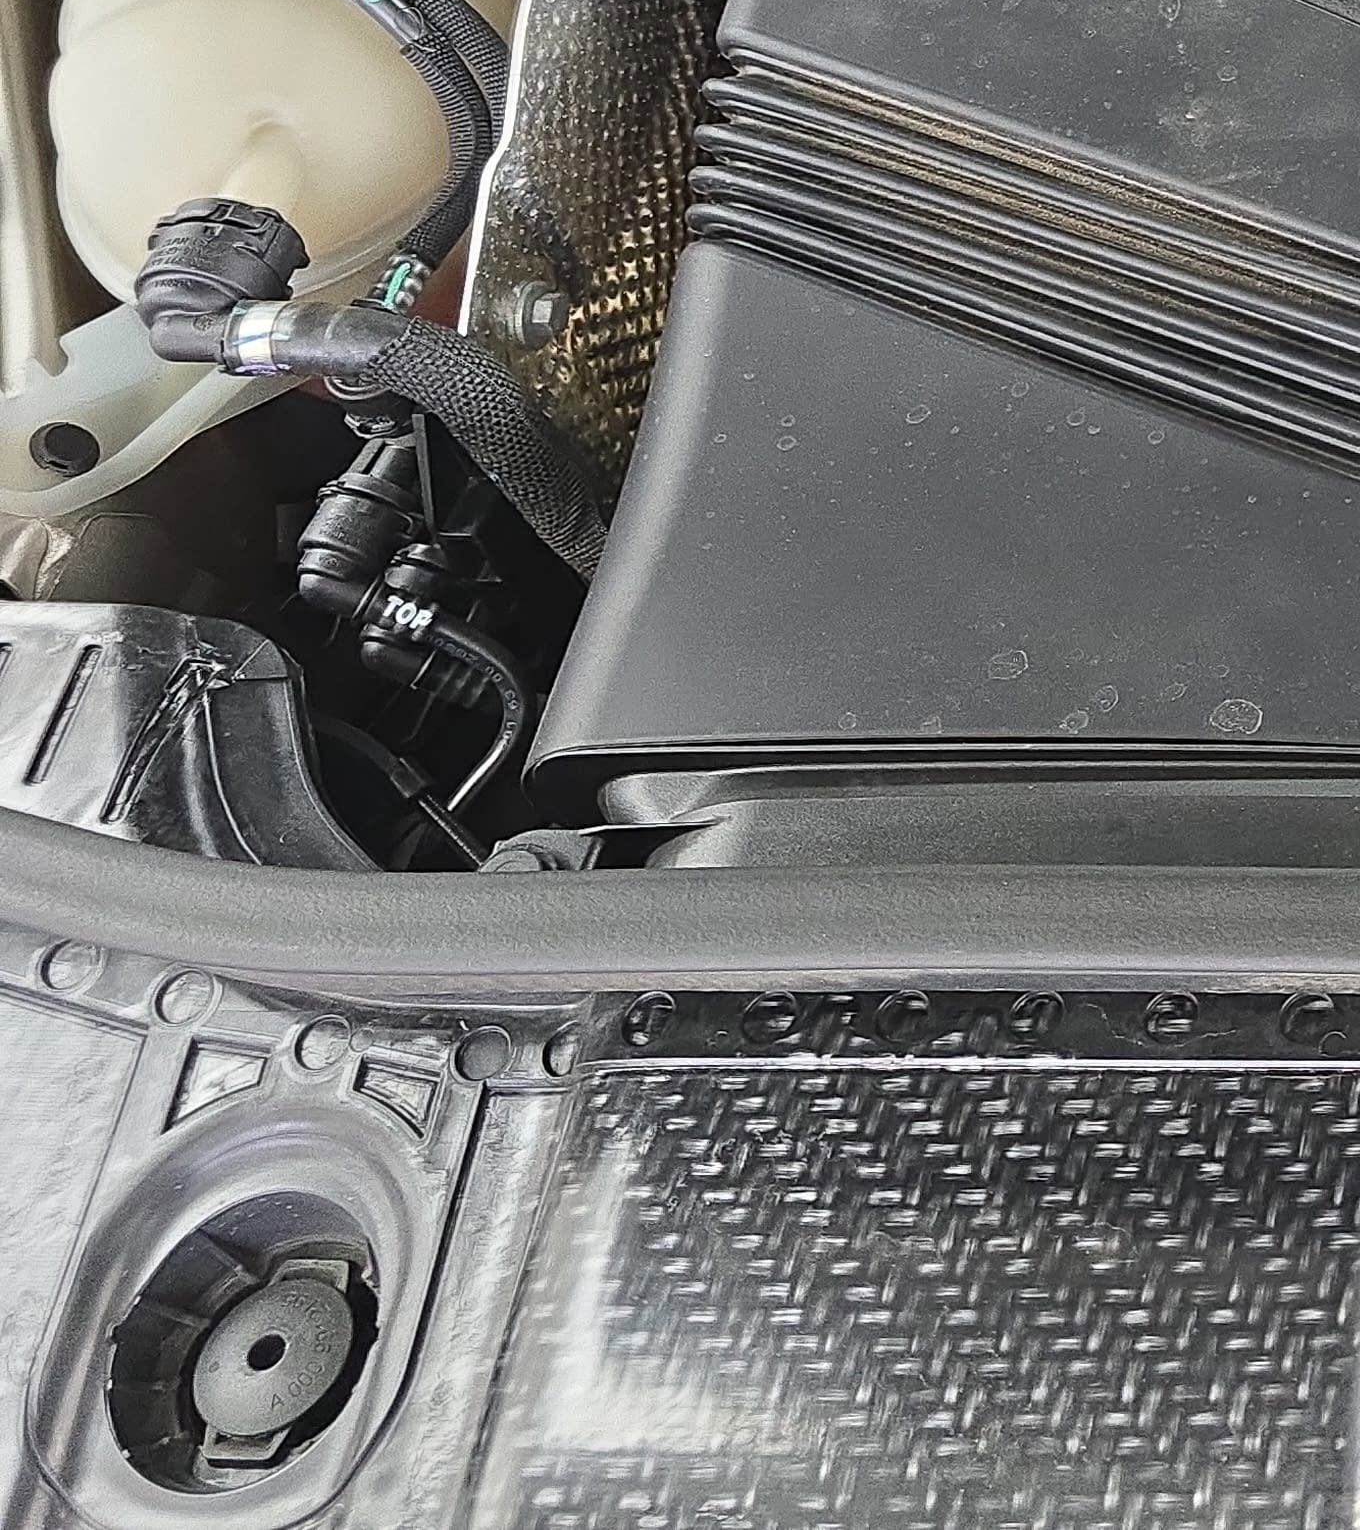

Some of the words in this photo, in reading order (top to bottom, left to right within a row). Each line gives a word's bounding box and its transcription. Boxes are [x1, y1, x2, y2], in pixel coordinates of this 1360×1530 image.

[382, 595, 434, 630] TOP
[271, 1393, 285, 1410] A
[288, 1360, 326, 1398] 000
